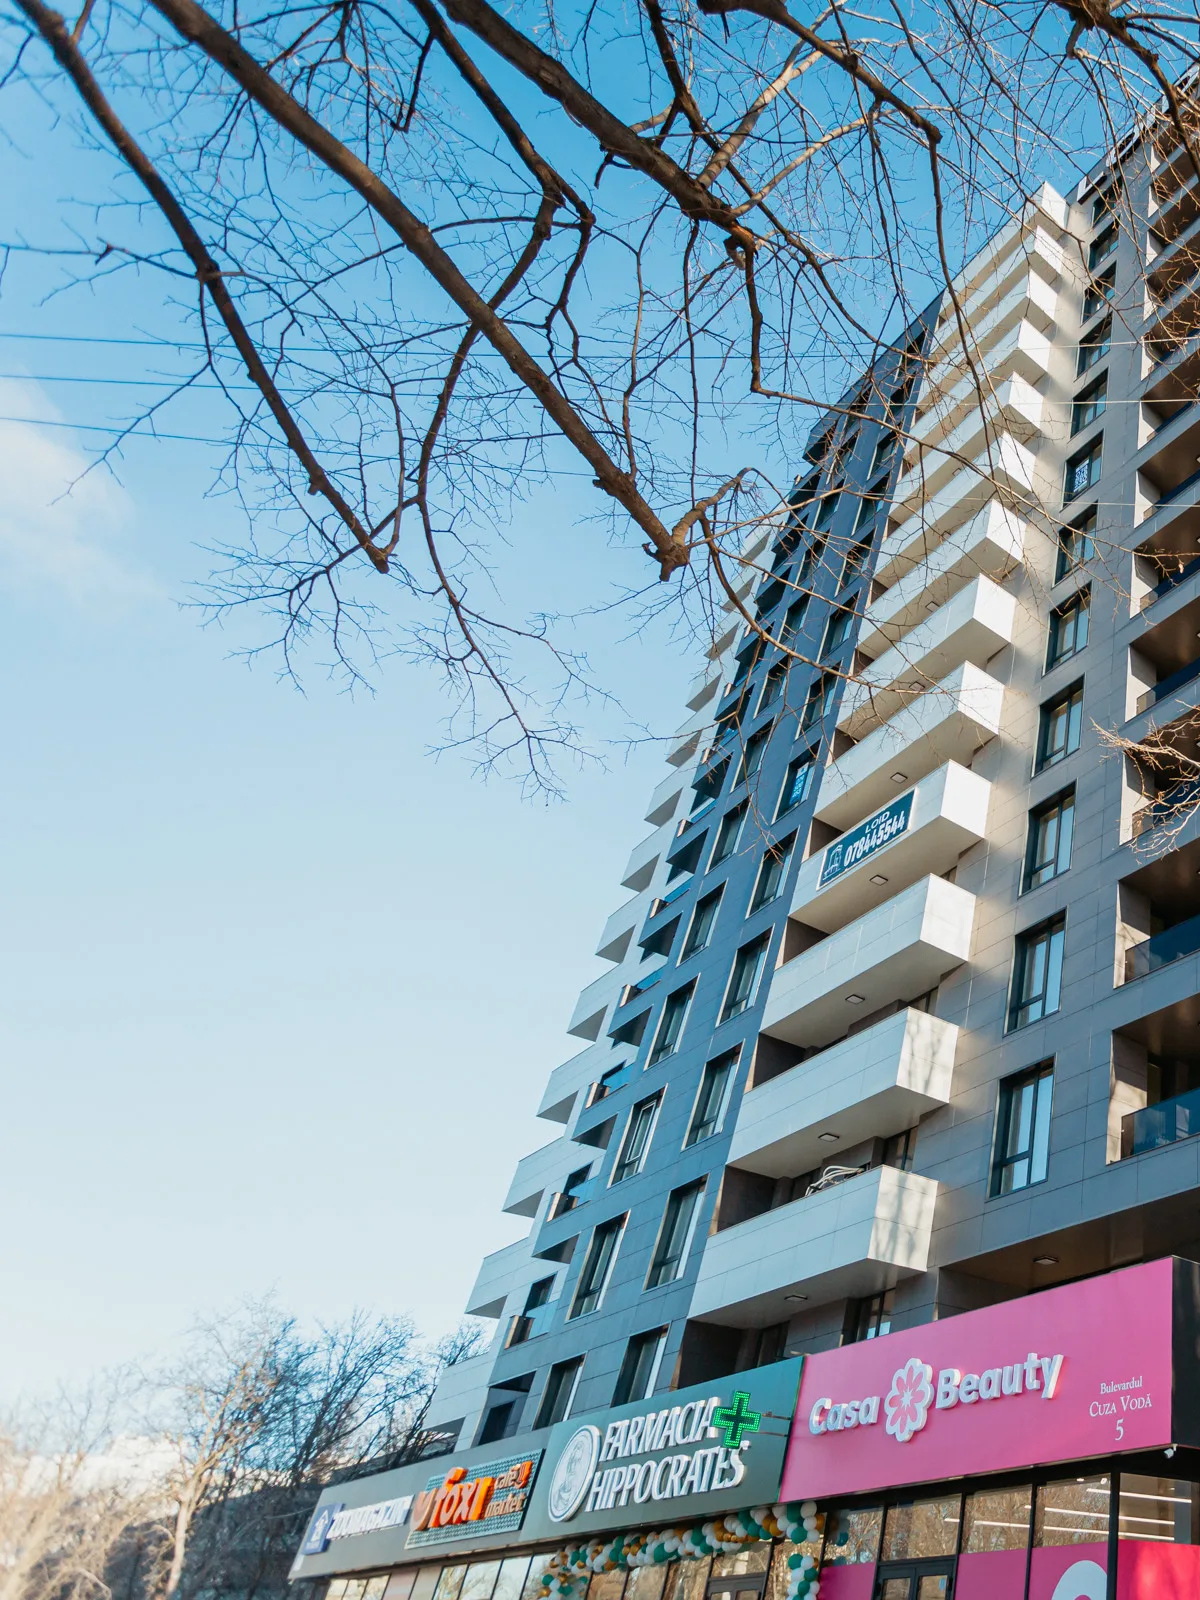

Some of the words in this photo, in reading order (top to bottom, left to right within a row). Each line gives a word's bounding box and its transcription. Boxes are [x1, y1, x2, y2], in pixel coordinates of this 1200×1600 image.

[865, 811, 890, 834] LOID
[844, 810, 905, 866] 078445544
[809, 1396, 881, 1435] Casa
[936, 1353, 1064, 1409] Beauty
[1100, 1376, 1143, 1394] Bulevardul
[1089, 1401, 1117, 1417] CUZA
[1120, 1393, 1152, 1412] VODĂ
[599, 1397, 721, 1461] FARMACIA
[1115, 1418, 1124, 1440] 5
[584, 1440, 750, 1512] HIPPOCRATES
[484, 1492, 526, 1518] market
